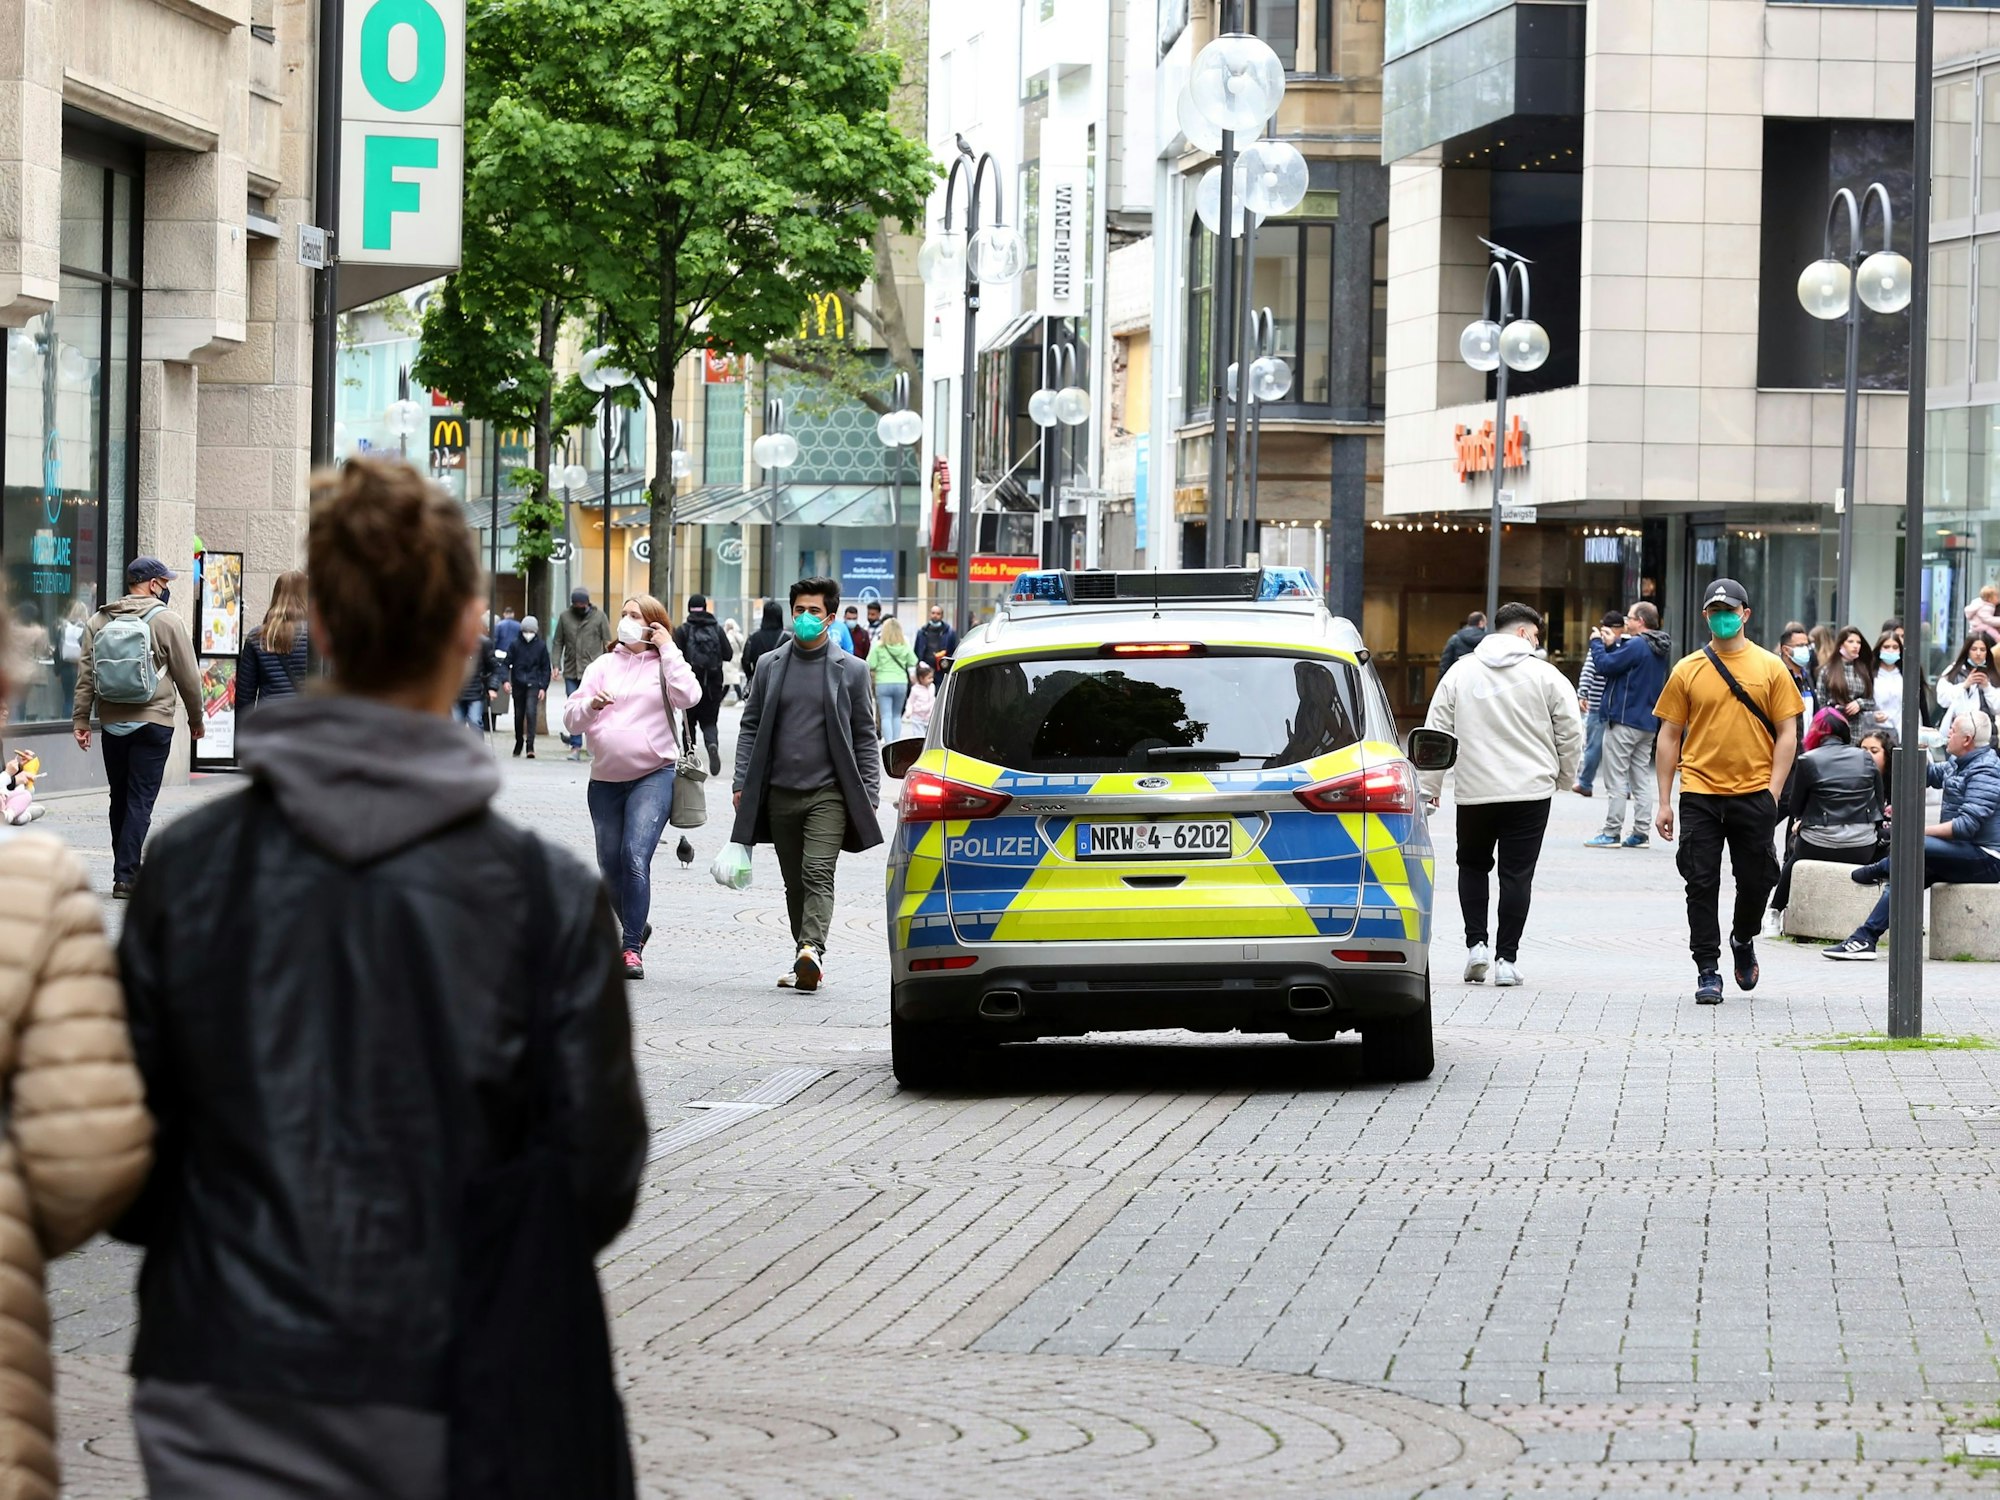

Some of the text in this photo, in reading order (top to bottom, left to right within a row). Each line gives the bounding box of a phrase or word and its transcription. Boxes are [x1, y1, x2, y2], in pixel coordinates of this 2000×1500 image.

[969, 562, 998, 575] rische
[949, 836, 1039, 858] POLIZEI
[1080, 842, 1087, 850] D
[1091, 826, 1134, 851] NRW
